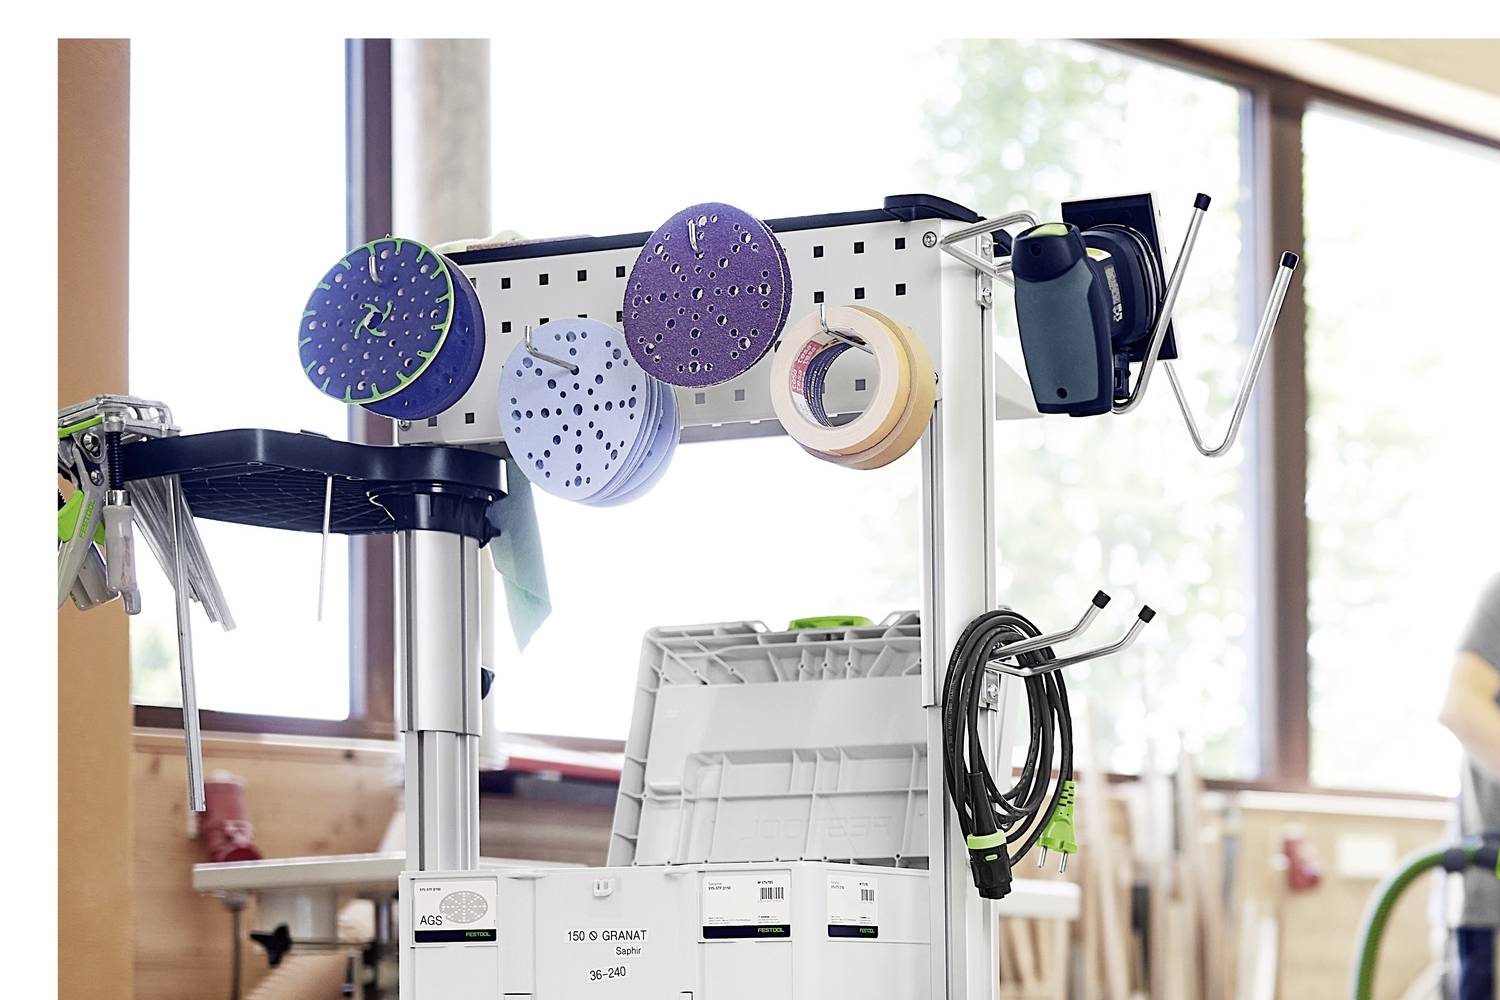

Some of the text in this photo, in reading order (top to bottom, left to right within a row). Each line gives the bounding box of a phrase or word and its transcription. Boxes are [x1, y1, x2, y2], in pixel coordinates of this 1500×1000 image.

[419, 914, 443, 926] AGS
[567, 930, 585, 941] 150
[602, 929, 647, 941] GRANAT
[615, 946, 642, 956] Saphir
[589, 965, 626, 981] 36-240
